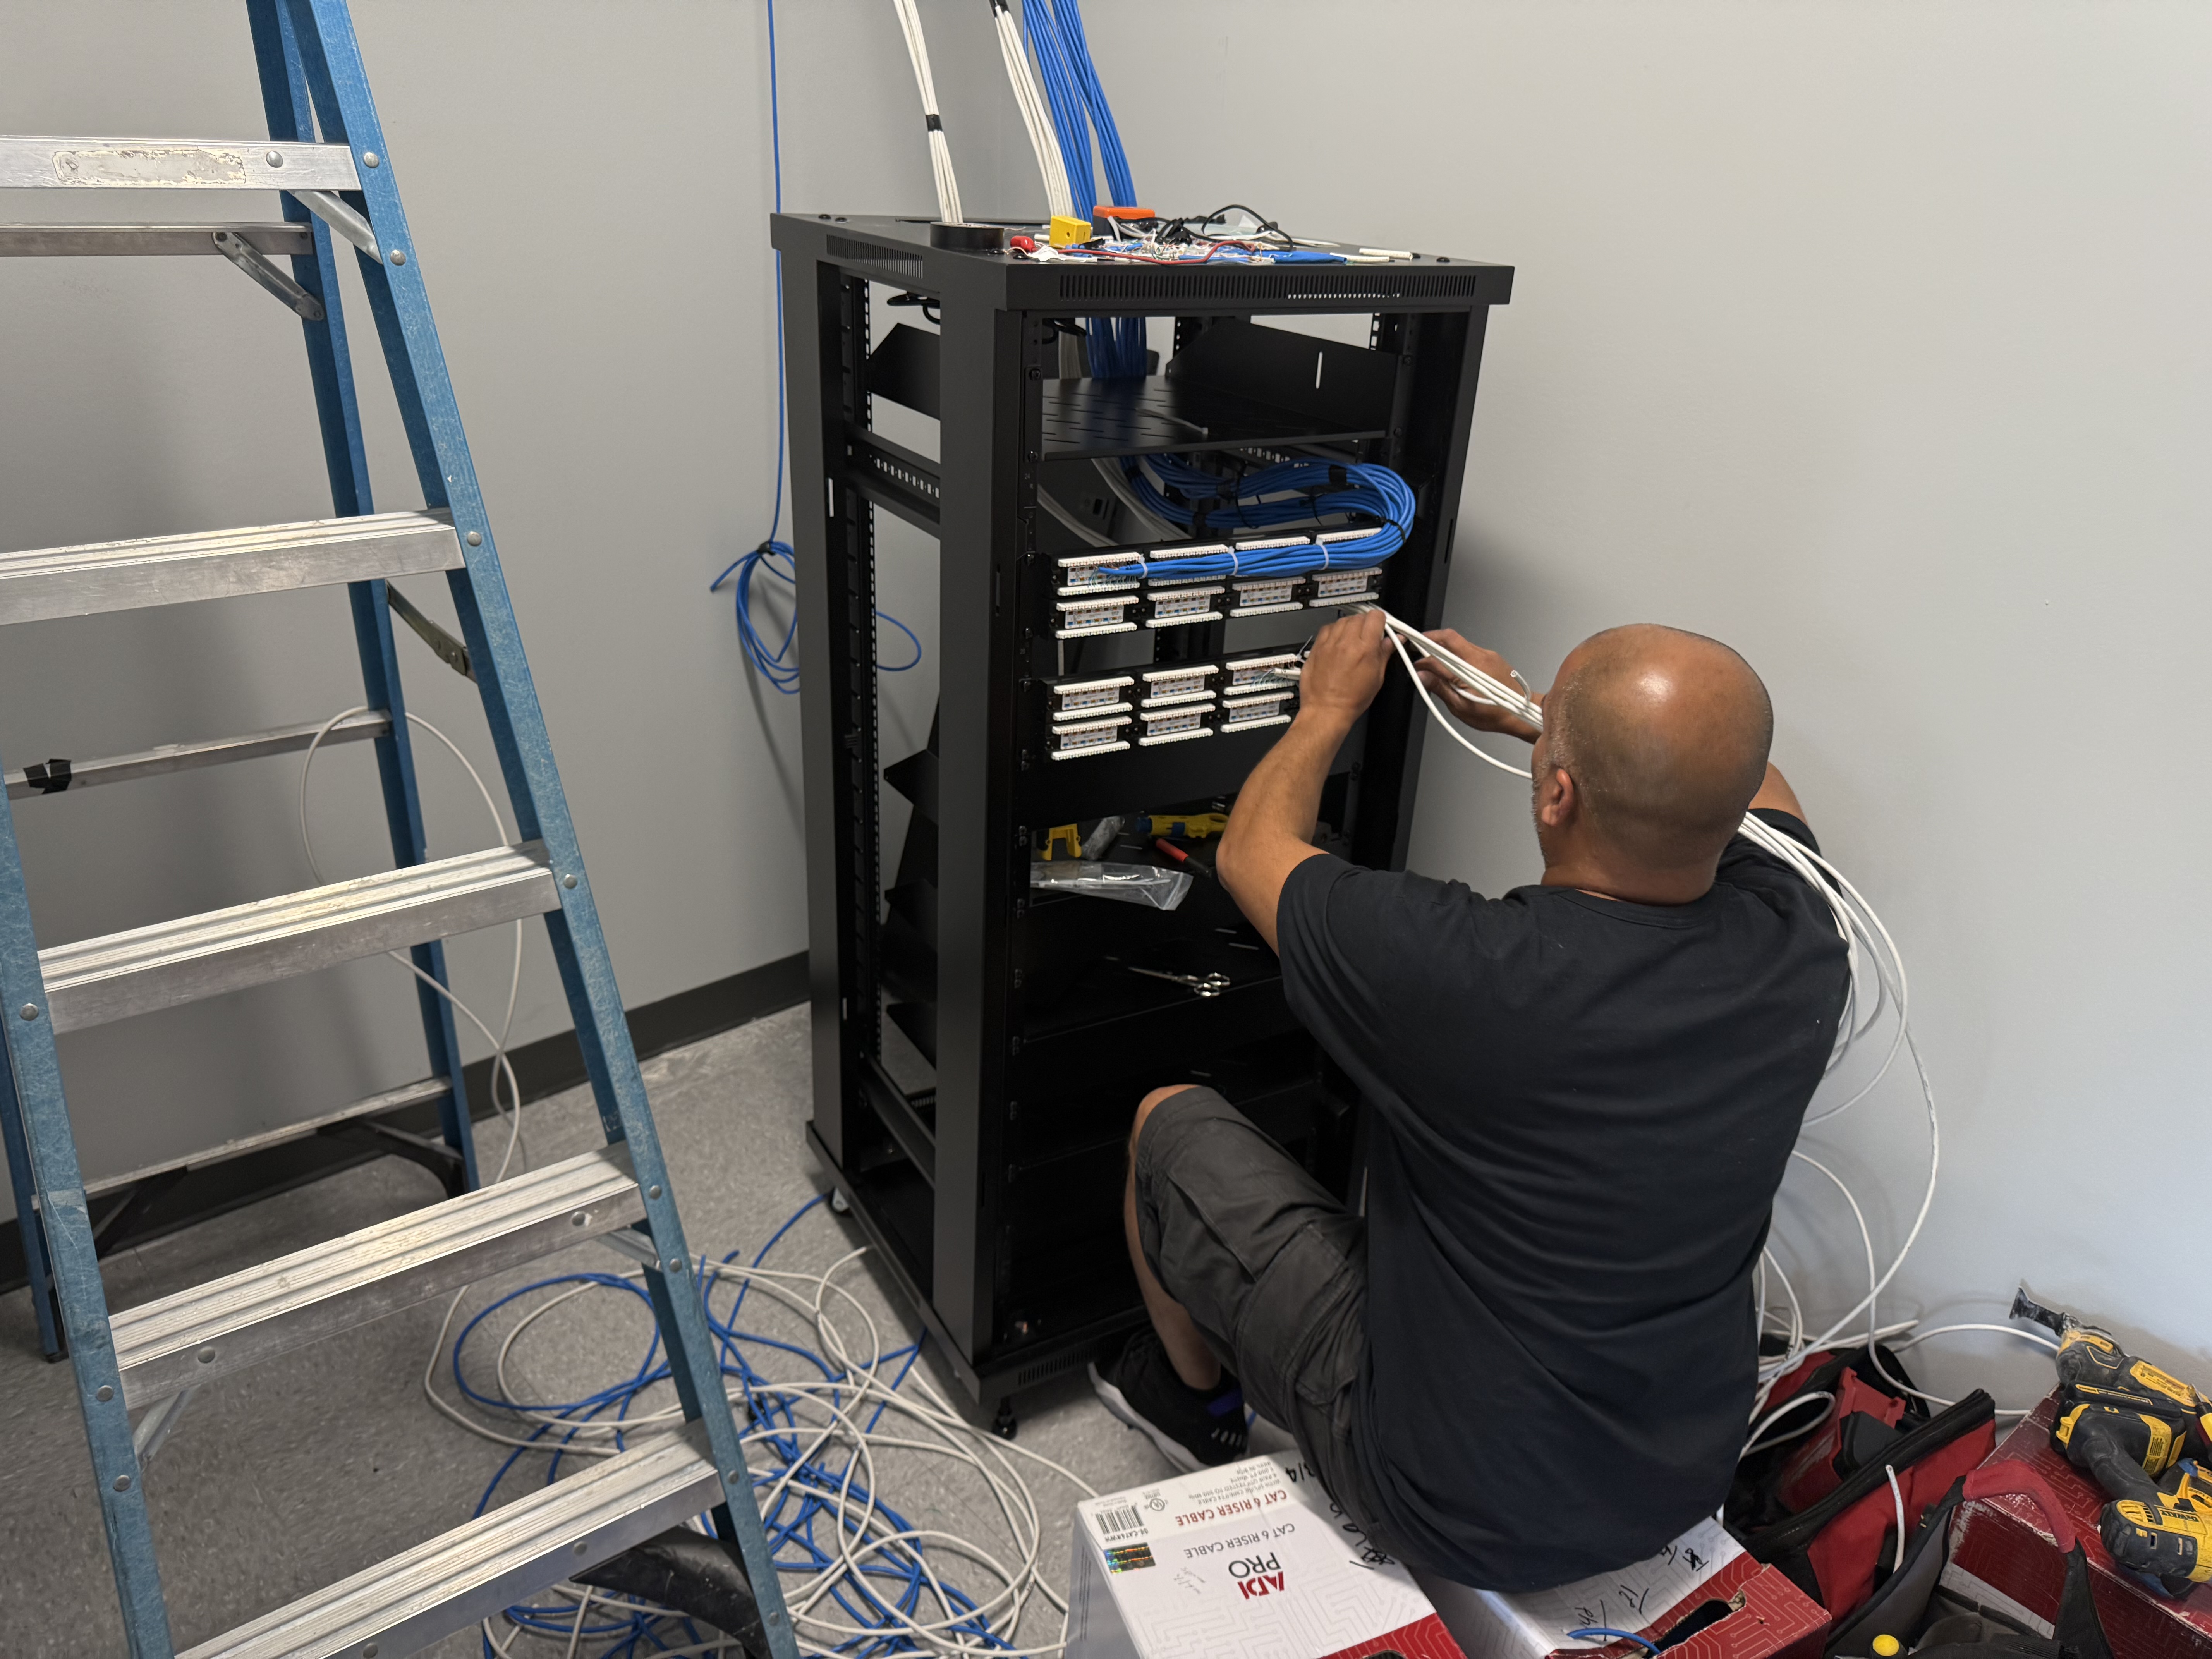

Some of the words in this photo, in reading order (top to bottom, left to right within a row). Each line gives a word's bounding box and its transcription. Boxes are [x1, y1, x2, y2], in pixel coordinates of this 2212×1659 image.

[1253, 1498, 1261, 1508] 6
[1264, 1490, 1287, 1505] CAT
[1217, 1499, 1253, 1516] RISER
[1175, 1509, 1215, 1526] CABLE
[1261, 1530, 1269, 1540] 6
[1273, 1523, 1295, 1538] CAT
[1225, 1532, 1261, 1549] RISER
[1183, 1542, 1224, 1559] CABLE
[1228, 1552, 1281, 1578] PRO
[1237, 1571, 1285, 1600] ADI
